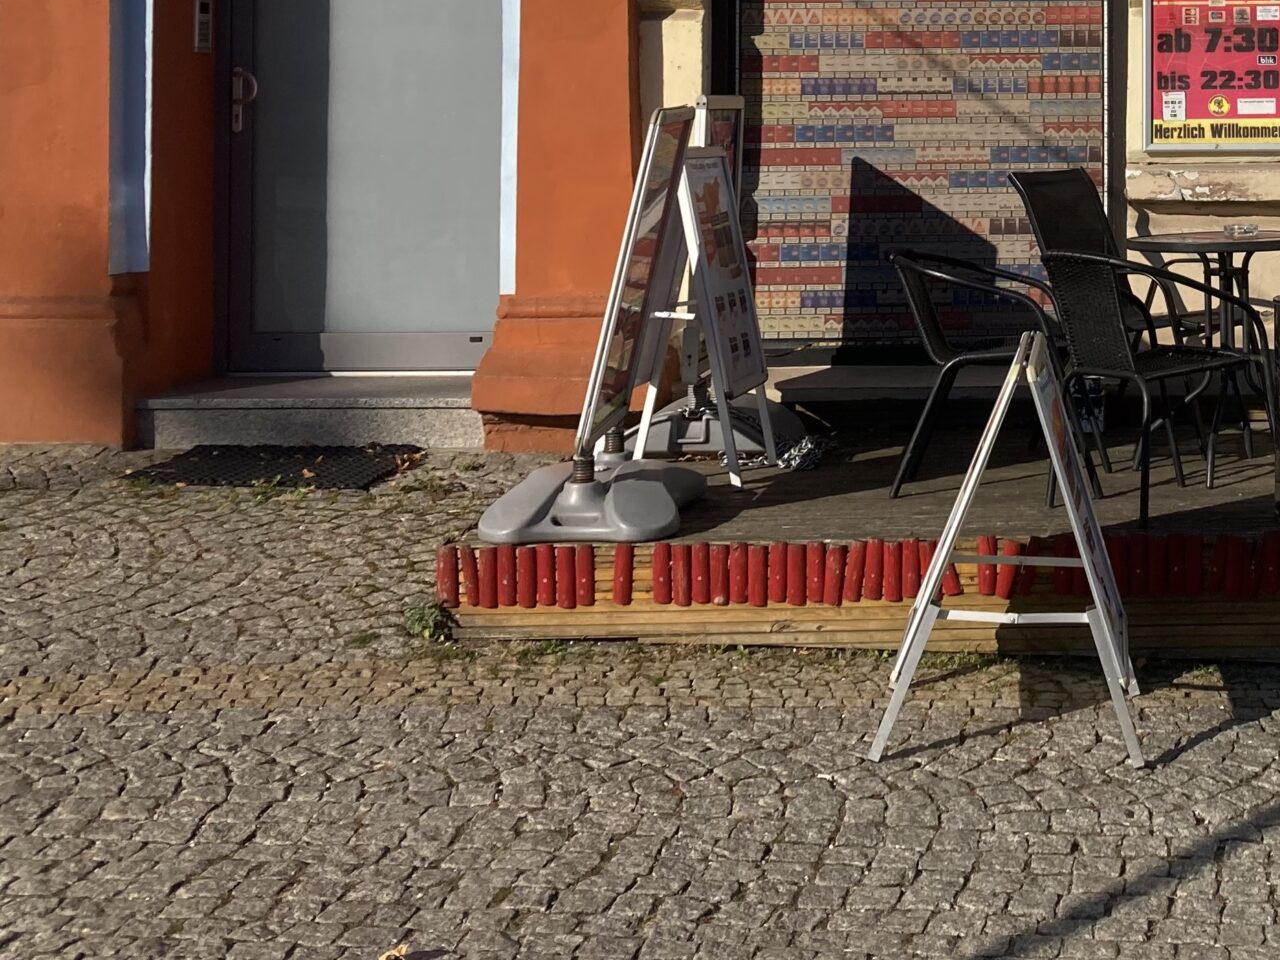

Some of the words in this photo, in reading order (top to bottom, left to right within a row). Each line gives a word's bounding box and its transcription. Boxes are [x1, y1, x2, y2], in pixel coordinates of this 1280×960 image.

[1157, 27, 1192, 53] ab
[1204, 27, 1280, 53] 7:30
[1260, 56, 1275, 64] blik
[1156, 71, 1191, 90] bis
[1200, 70, 1280, 90] 22:30
[1154, 123, 1205, 139] Herzlich
